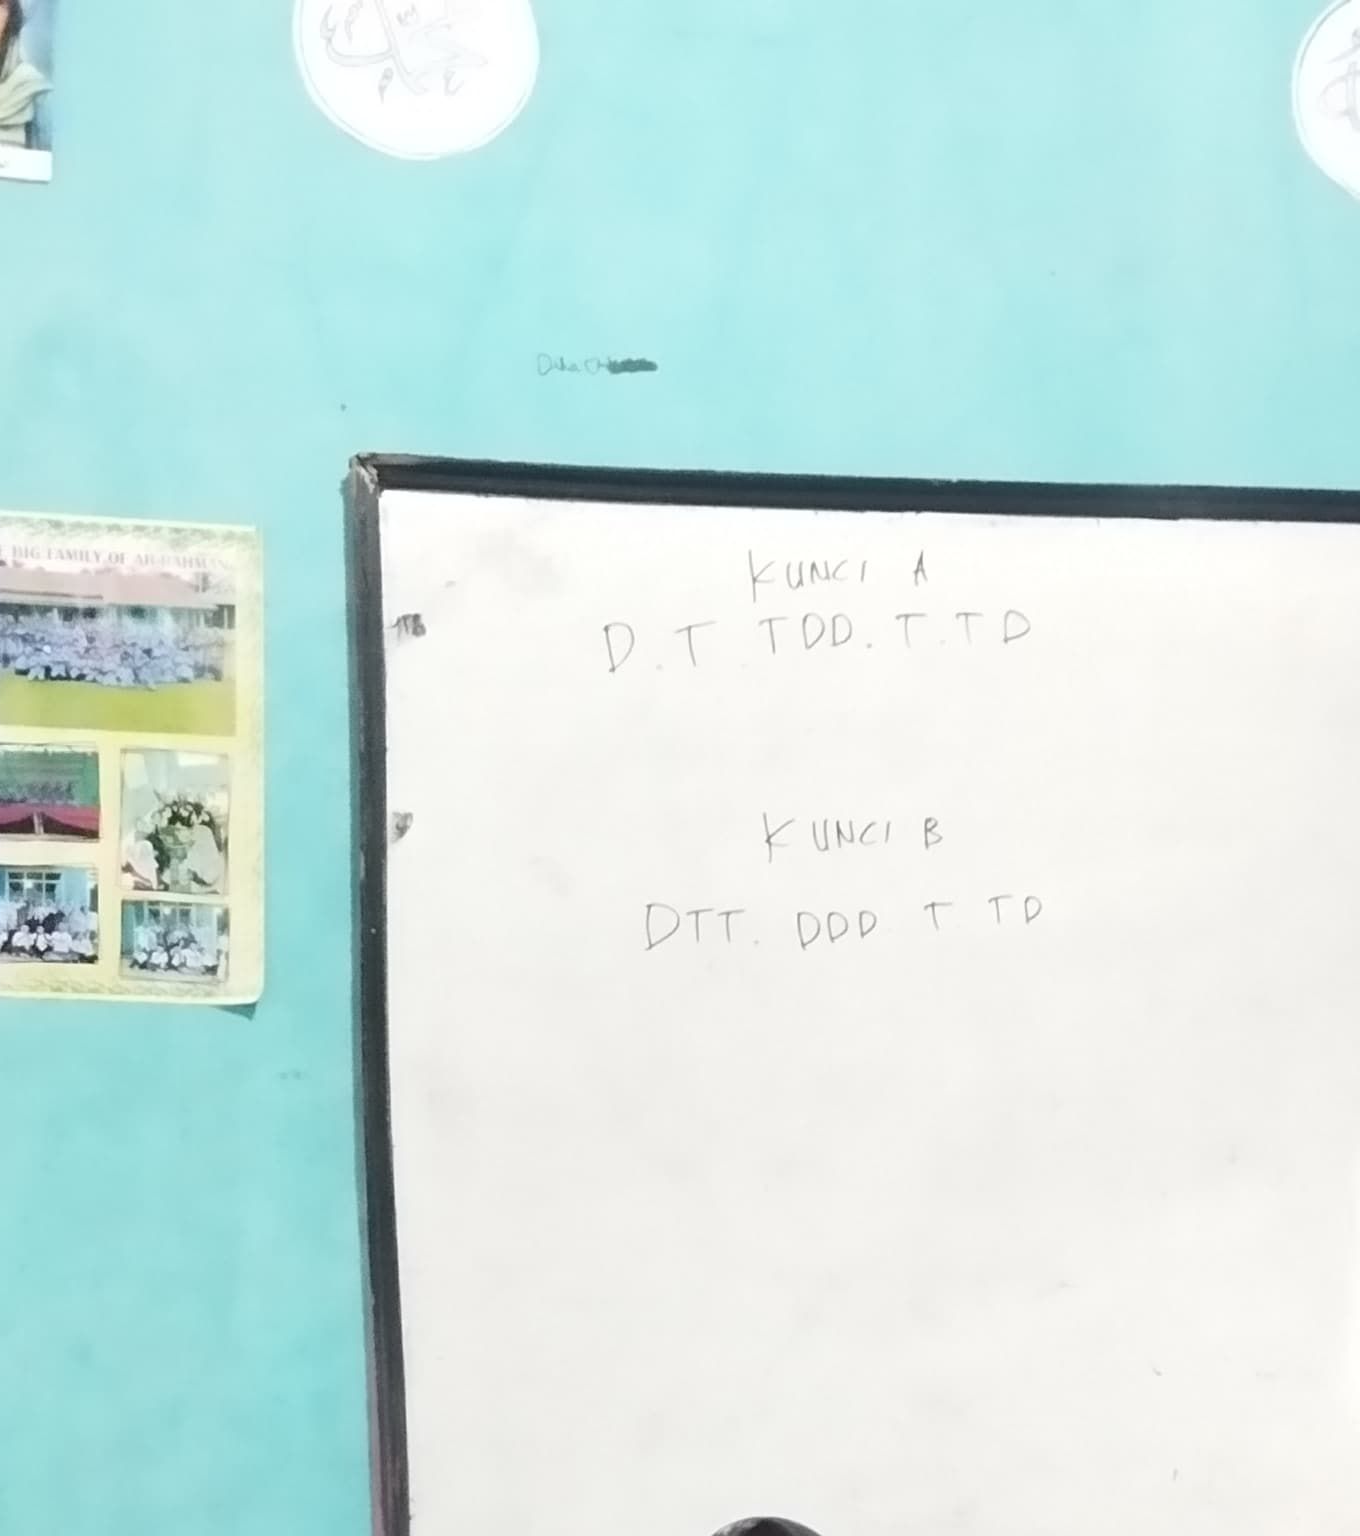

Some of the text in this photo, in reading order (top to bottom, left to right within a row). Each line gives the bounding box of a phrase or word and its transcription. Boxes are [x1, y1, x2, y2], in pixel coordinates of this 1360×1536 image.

[11, 544, 41, 560] BIG
[47, 547, 102, 563] FAMILY
[107, 551, 126, 565] OF
[746, 548, 929, 603] KUNCI A
[762, 811, 944, 863] KUNCI B
